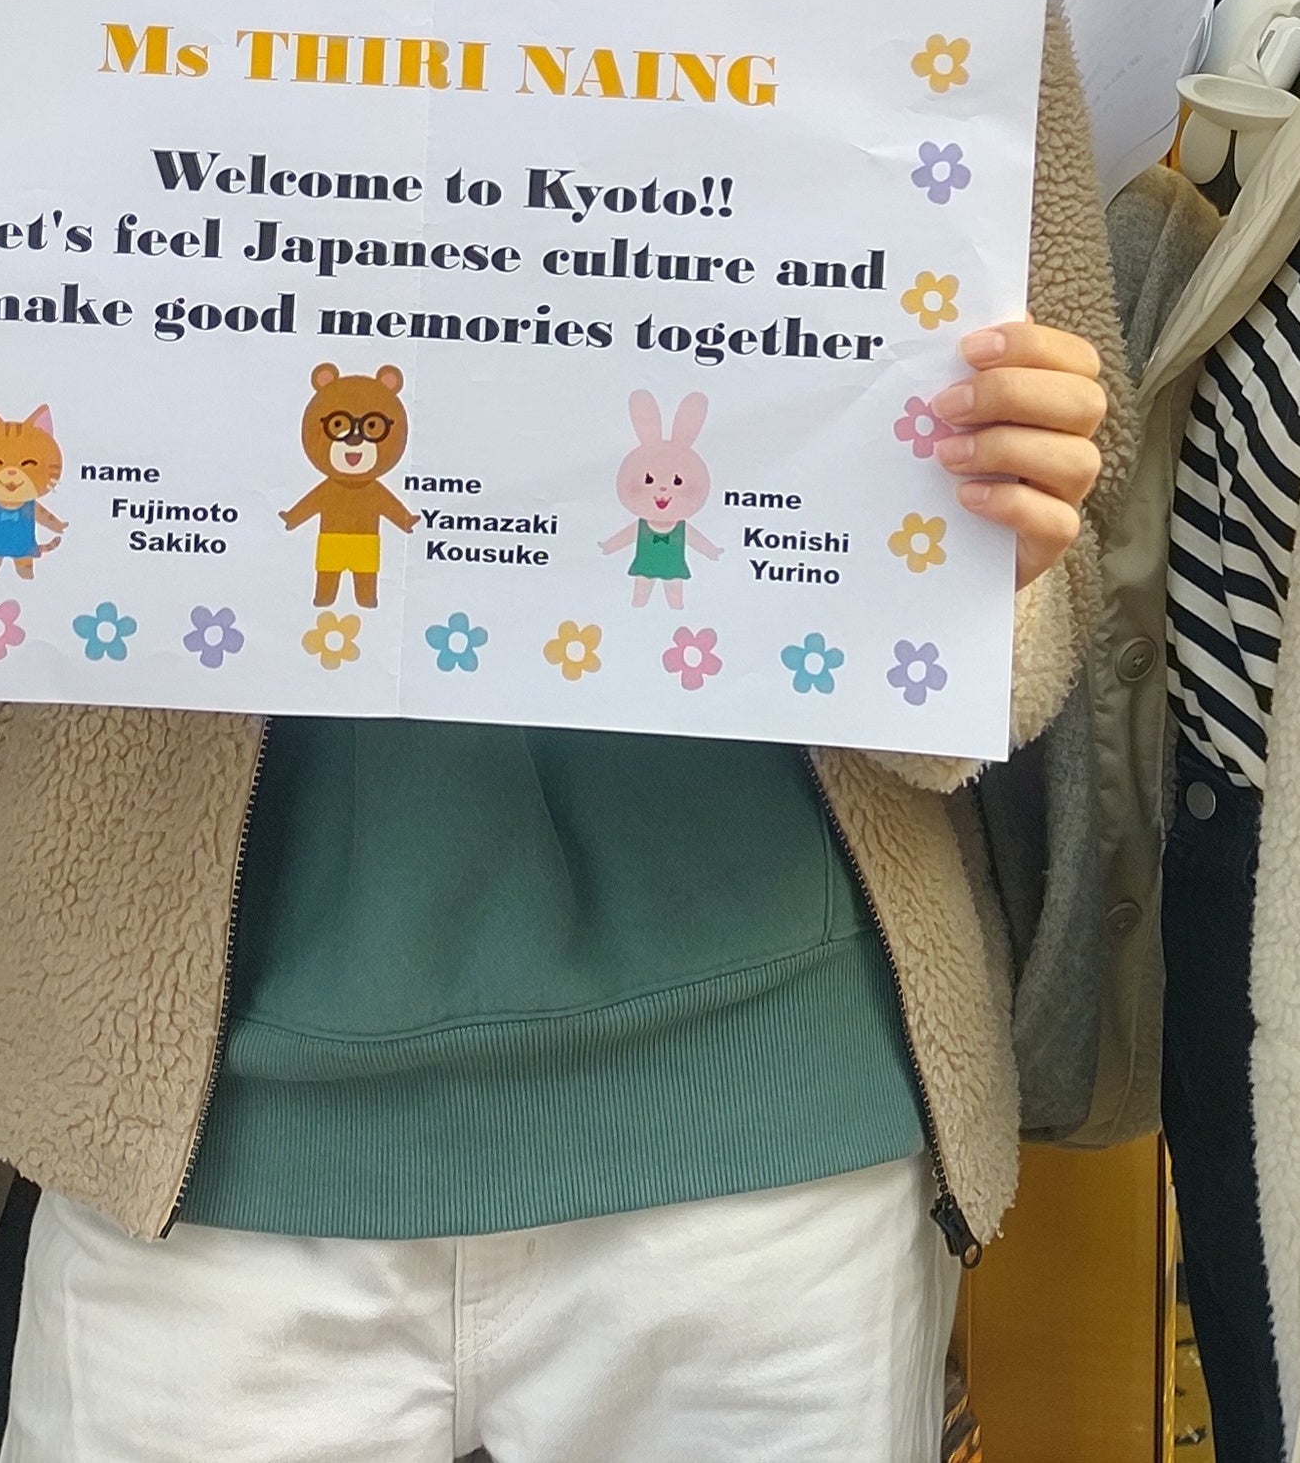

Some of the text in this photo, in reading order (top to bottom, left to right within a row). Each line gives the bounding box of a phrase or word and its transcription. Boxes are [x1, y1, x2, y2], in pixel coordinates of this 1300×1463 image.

[100, 23, 779, 107] Ms THIRI NAING
[152, 149, 734, 224] Welcome to Kyoto!!
[113, 213, 223, 259] feel
[243, 220, 522, 278] Japanese
[542, 238, 756, 284] culture
[775, 249, 886, 291] and
[154, 293, 298, 341] good
[317, 304, 614, 349] memories
[634, 315, 885, 366] together
[80, 465, 160, 483] name
[403, 475, 482, 495] name
[111, 498, 239, 525] Fujimoto
[723, 490, 803, 510] name
[420, 508, 558, 535] Yamazaki
[128, 530, 227, 554] Sakiko
[425, 540, 550, 566] Kousuke
[742, 527, 850, 553] Konishi
[748, 559, 841, 585] Yurino
